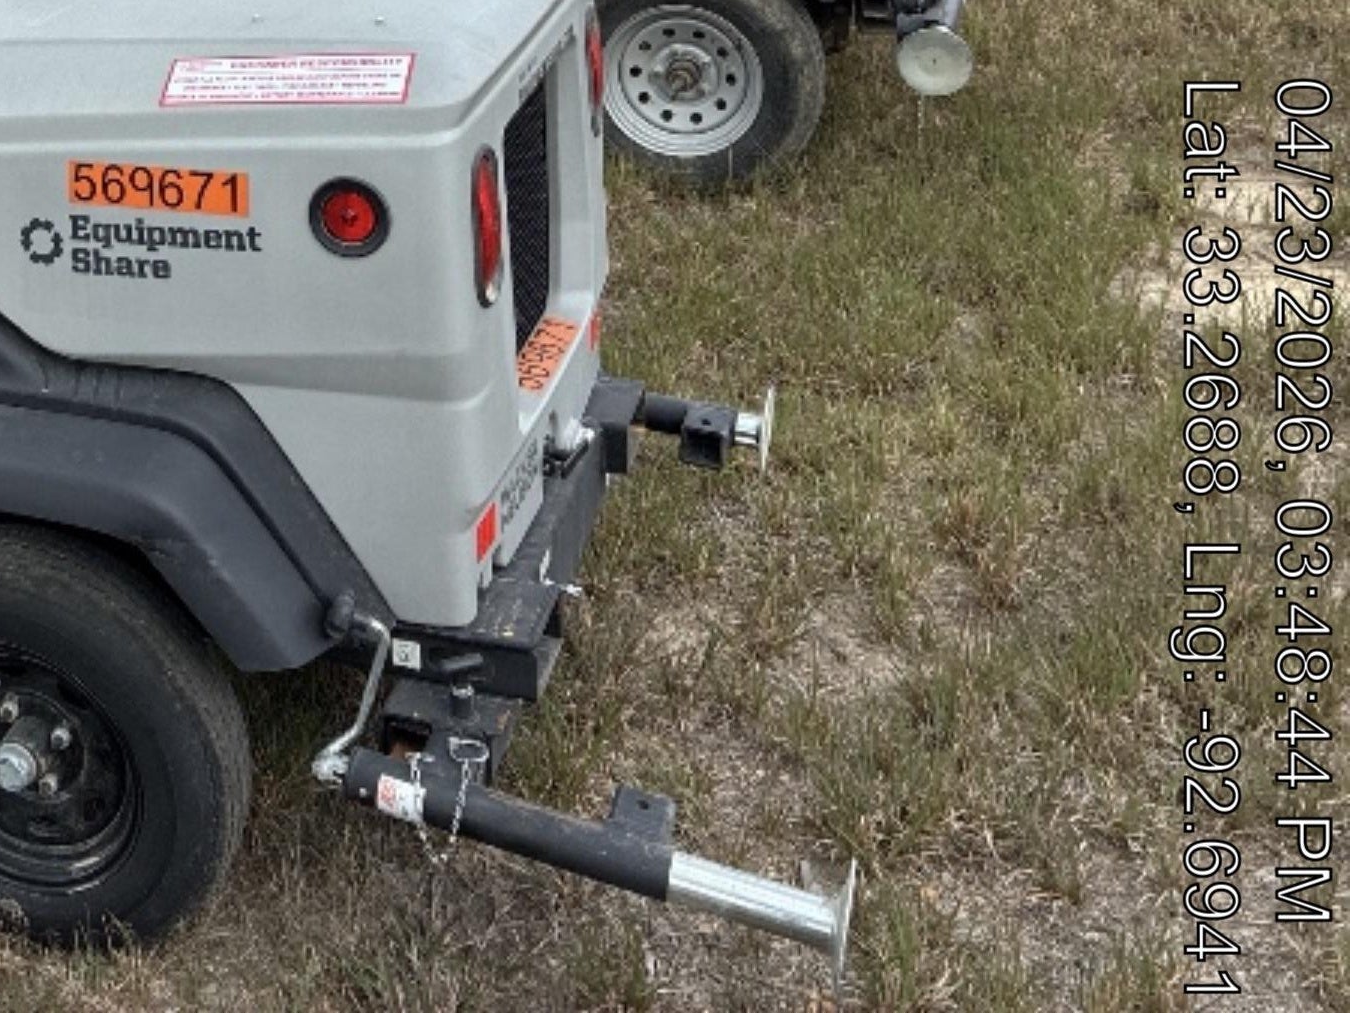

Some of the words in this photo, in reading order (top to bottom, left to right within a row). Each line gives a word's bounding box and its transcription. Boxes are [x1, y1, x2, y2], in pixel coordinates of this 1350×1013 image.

[73, 163, 239, 213] 569671
[69, 215, 263, 252] Equipment
[71, 248, 172, 279] Share
